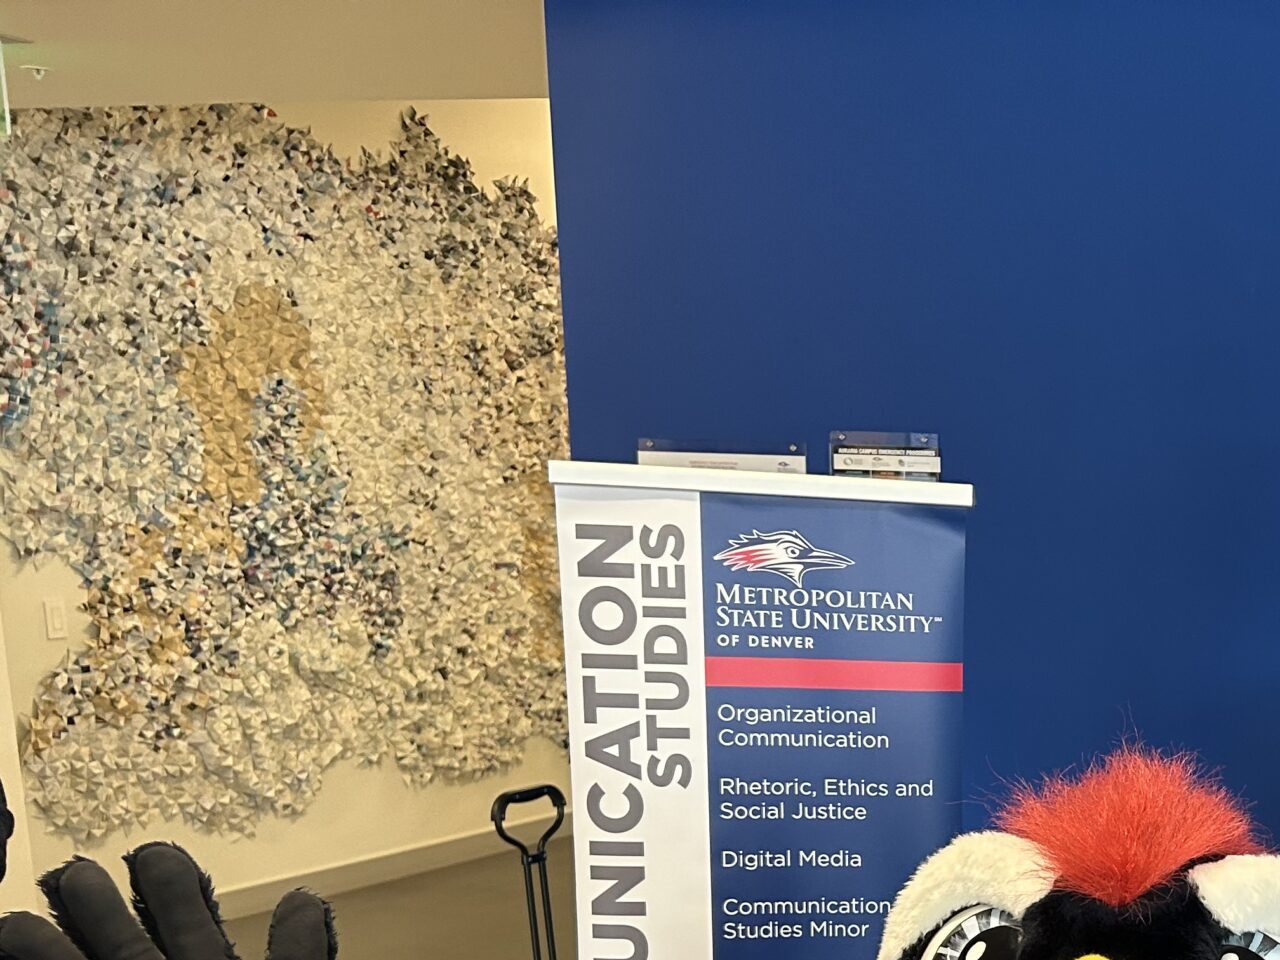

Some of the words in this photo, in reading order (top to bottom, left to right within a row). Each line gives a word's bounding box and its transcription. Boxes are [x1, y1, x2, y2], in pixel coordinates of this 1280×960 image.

[716, 583, 913, 611] METROPOLITAN
[716, 606, 783, 628] STATE
[790, 610, 932, 633] UNIVERSITY
[717, 634, 740, 646] OF
[748, 636, 814, 649] DENVER
[639, 523, 692, 788] STUDIES
[718, 704, 877, 726] Organizational
[718, 729, 890, 748] Communication
[719, 778, 817, 800] Rhetoric,
[824, 778, 889, 797] Ethics
[895, 780, 934, 798] and
[720, 802, 784, 820] Social
[792, 803, 868, 821] Justice
[722, 850, 792, 871] Digital
[799, 851, 862, 868] Media
[723, 898, 891, 916] Communication
[723, 921, 802, 939] Studies
[810, 921, 869, 938] Minor
